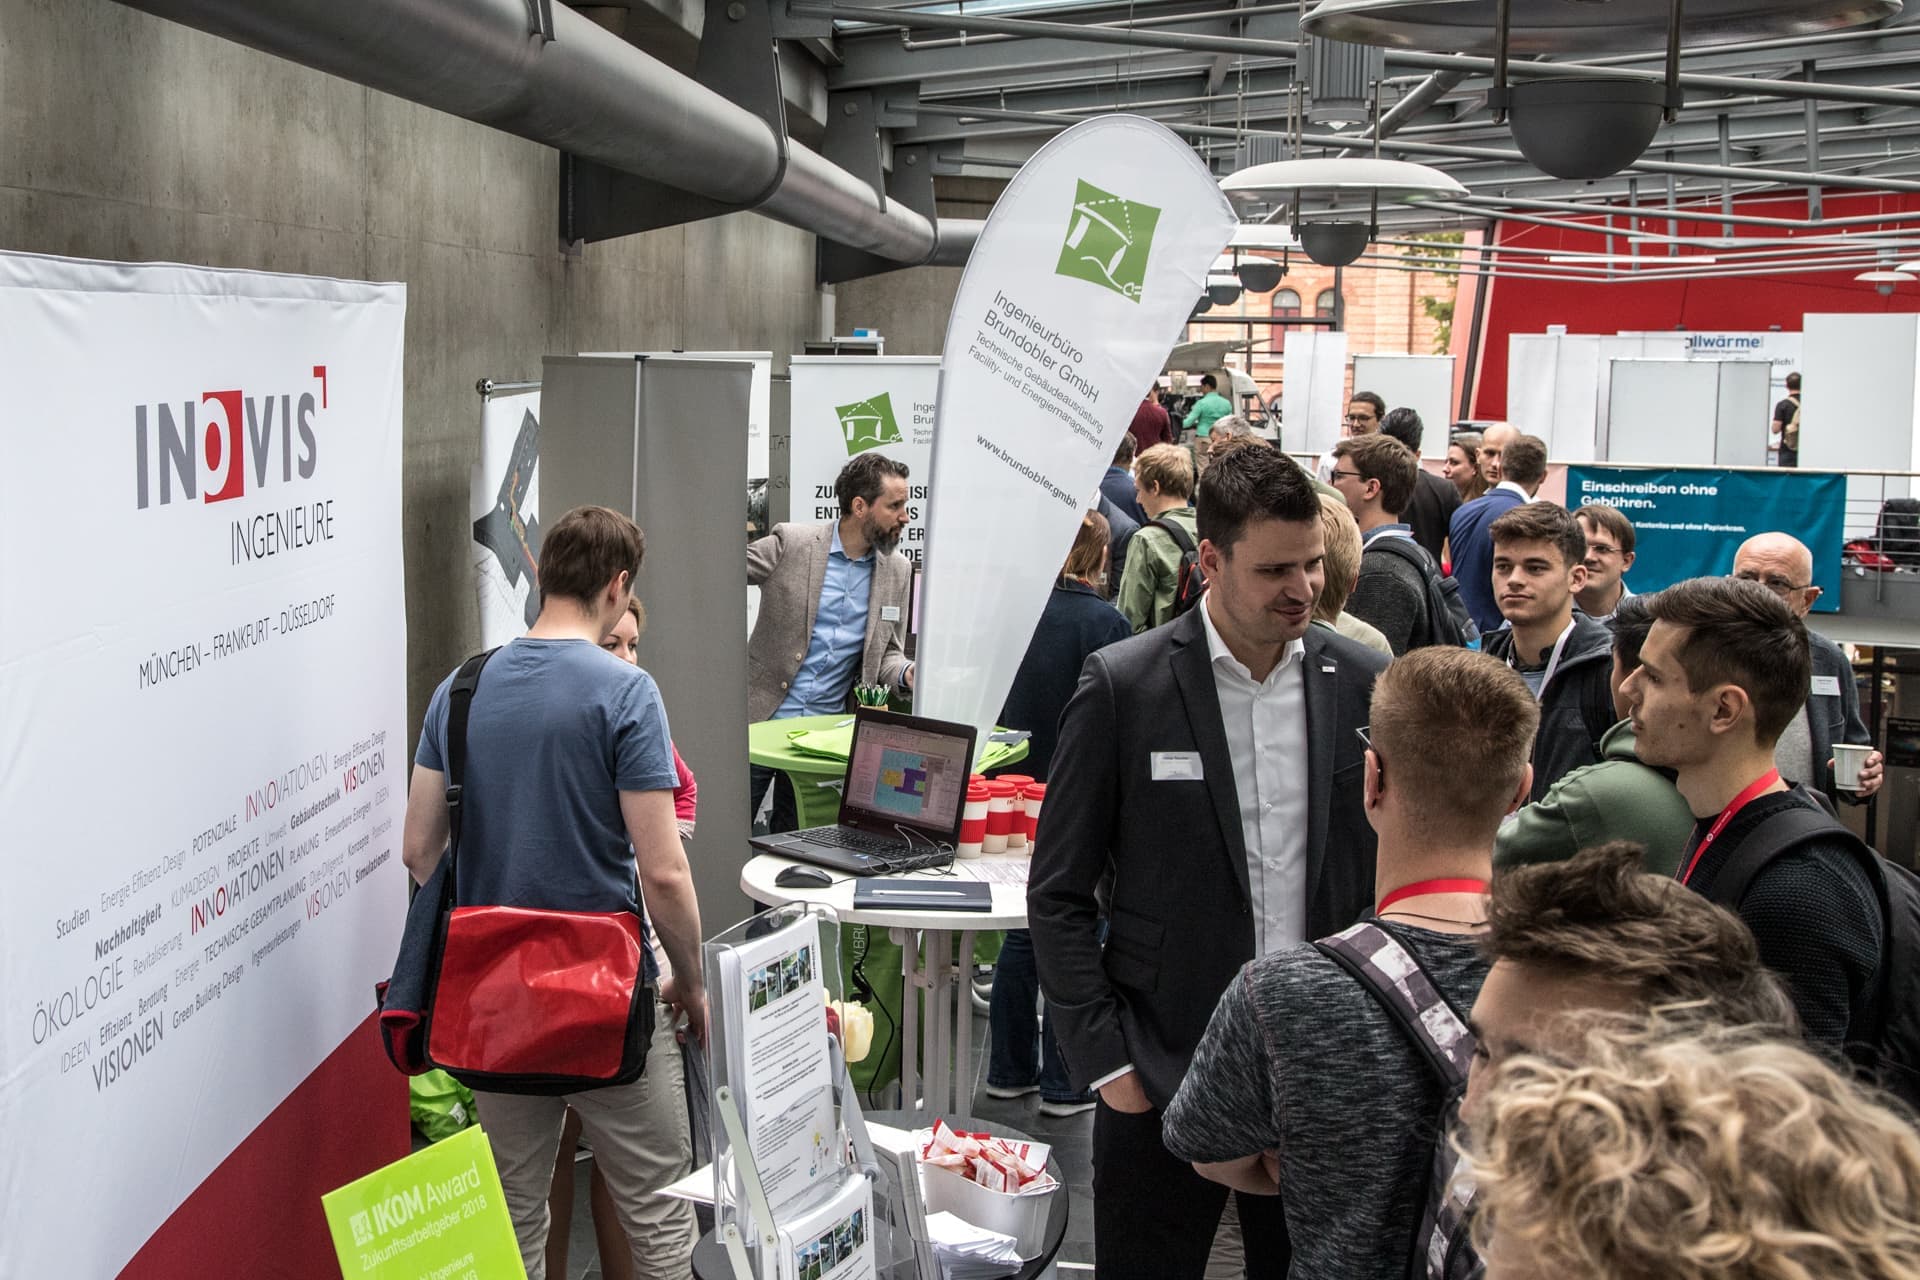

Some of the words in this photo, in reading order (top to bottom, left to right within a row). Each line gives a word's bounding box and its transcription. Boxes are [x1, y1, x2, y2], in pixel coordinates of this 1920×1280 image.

[984, 309, 1058, 371] Brundobler
[1058, 364, 1100, 404] GmbH
[993, 290, 1084, 364] Ingenieurbüro
[1692, 333, 1760, 348] llwärme
[968, 345, 1004, 375] Facility-
[1003, 370, 1021, 389] und
[1021, 382, 1103, 450] Energiemanagement
[975, 331, 1023, 372] Technische
[1023, 367, 1104, 434] Gebäudeausrüstung
[135, 387, 318, 510] INOVIS
[977, 434, 1078, 510] www.brundobler.gmbh
[1581, 480, 1677, 495] Einschreiben
[1679, 484, 1718, 496] ohne
[230, 499, 334, 566] INGENIEURE
[139, 644, 202, 690] MÜNCHEN
[213, 615, 271, 660] FRANKFURT
[280, 594, 335, 637] DÜSSELDORF
[56, 908, 90, 940] Studien
[100, 882, 131, 913] Energie
[132, 866, 162, 897] Effizienz
[162, 849, 186, 875] Design
[192, 814, 238, 856] POTENZIALE
[245, 751, 329, 823] INNOVATIONEN
[334, 750, 352, 770] Energie
[95, 903, 162, 961] Nachhaltigkeit
[170, 863, 220, 909] KLIMADESIGN
[227, 837, 260, 872] PROJEKTE
[264, 824, 287, 847] Umwelt
[290, 787, 341, 830] Gebäudetechnik
[343, 748, 386, 794] VISIONEN
[32, 956, 124, 1045] ÖKOLOGIE
[132, 932, 183, 977] Revitalisierung
[191, 846, 285, 936] INNOVATIONEN
[289, 833, 320, 866] PLANUNG
[60, 1036, 91, 1075] IDEEN
[100, 1011, 133, 1047] Effizienz
[138, 983, 169, 1017] Beratung
[175, 959, 200, 988] Energie
[204, 918, 250, 964] TECHNISCHE
[250, 875, 307, 930] GESAMTPLANUNG
[92, 1010, 164, 1094] VISIONEN
[172, 1003, 194, 1029] Green
[195, 980, 222, 1012] Building
[222, 963, 244, 990] Design
[305, 866, 351, 921] VISIONEN
[355, 848, 391, 884] Simulationen
[360, 1208, 462, 1272] Zukunftsarbeitgeber
[463, 1194, 488, 1218] 2018
[371, 1183, 425, 1236] IKOM
[426, 1160, 481, 1212] Award
